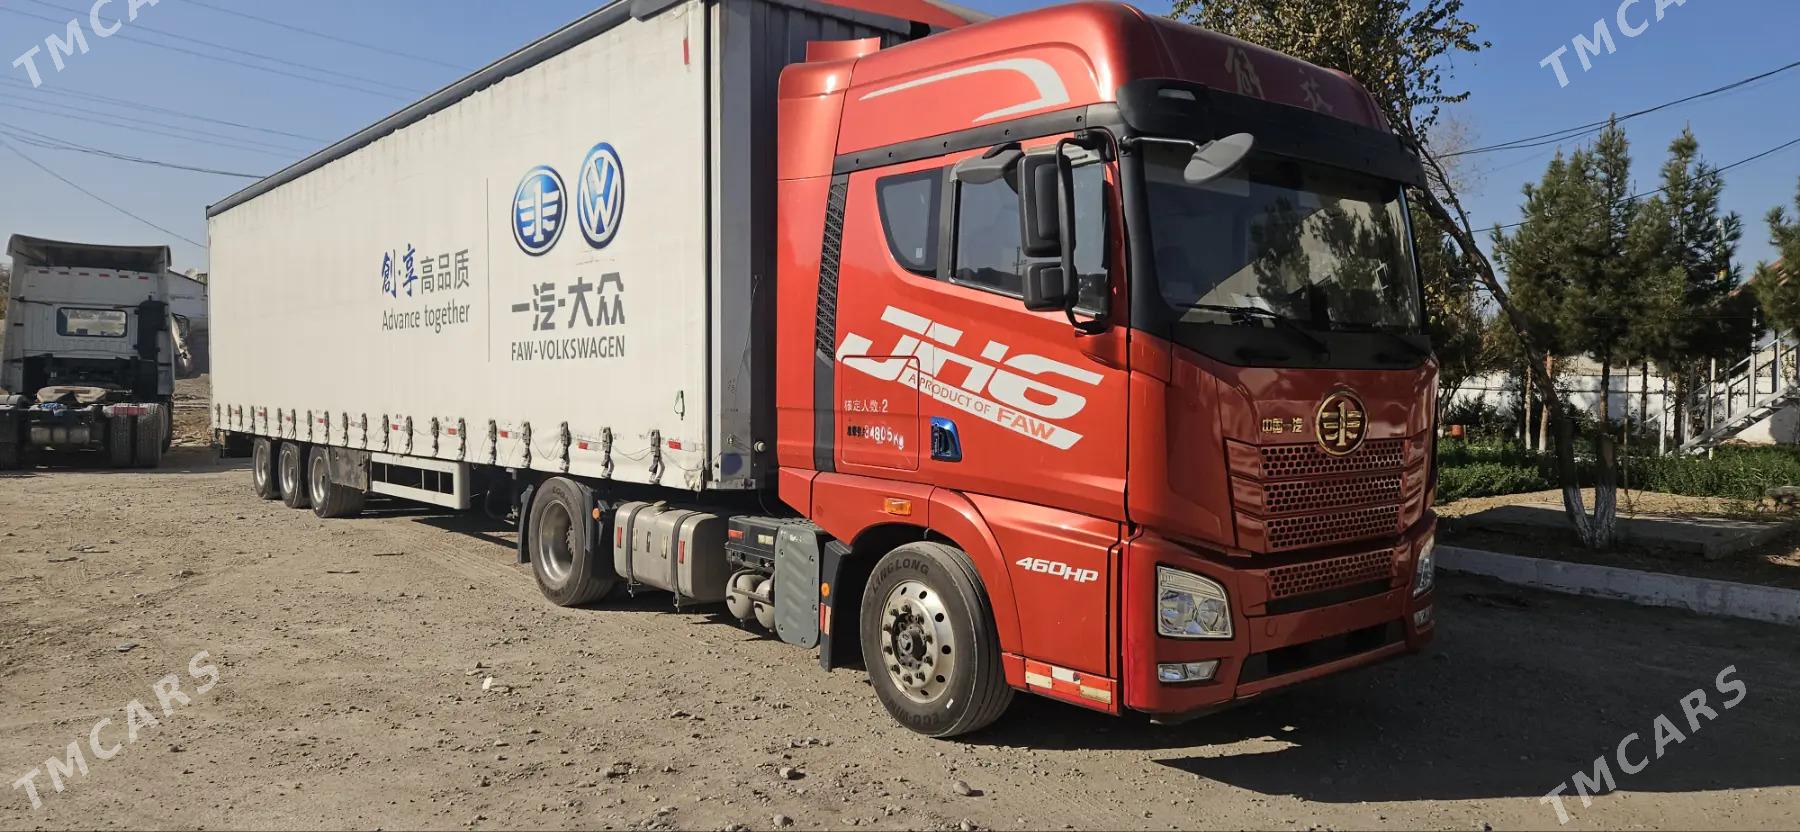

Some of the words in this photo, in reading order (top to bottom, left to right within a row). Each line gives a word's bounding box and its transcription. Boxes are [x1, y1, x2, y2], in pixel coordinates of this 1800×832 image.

[382, 307, 420, 332] Advance
[424, 299, 470, 334] together
[511, 335, 625, 361] FAW-VOLKSWAGEN
[836, 304, 1105, 419] JH6
[908, 373, 917, 385] A
[919, 376, 971, 407] PRODUCT
[973, 399, 992, 414] OF
[997, 407, 1056, 441] FAW
[872, 558, 930, 594] LINGLONG
[1015, 556, 1099, 583] 460HP
